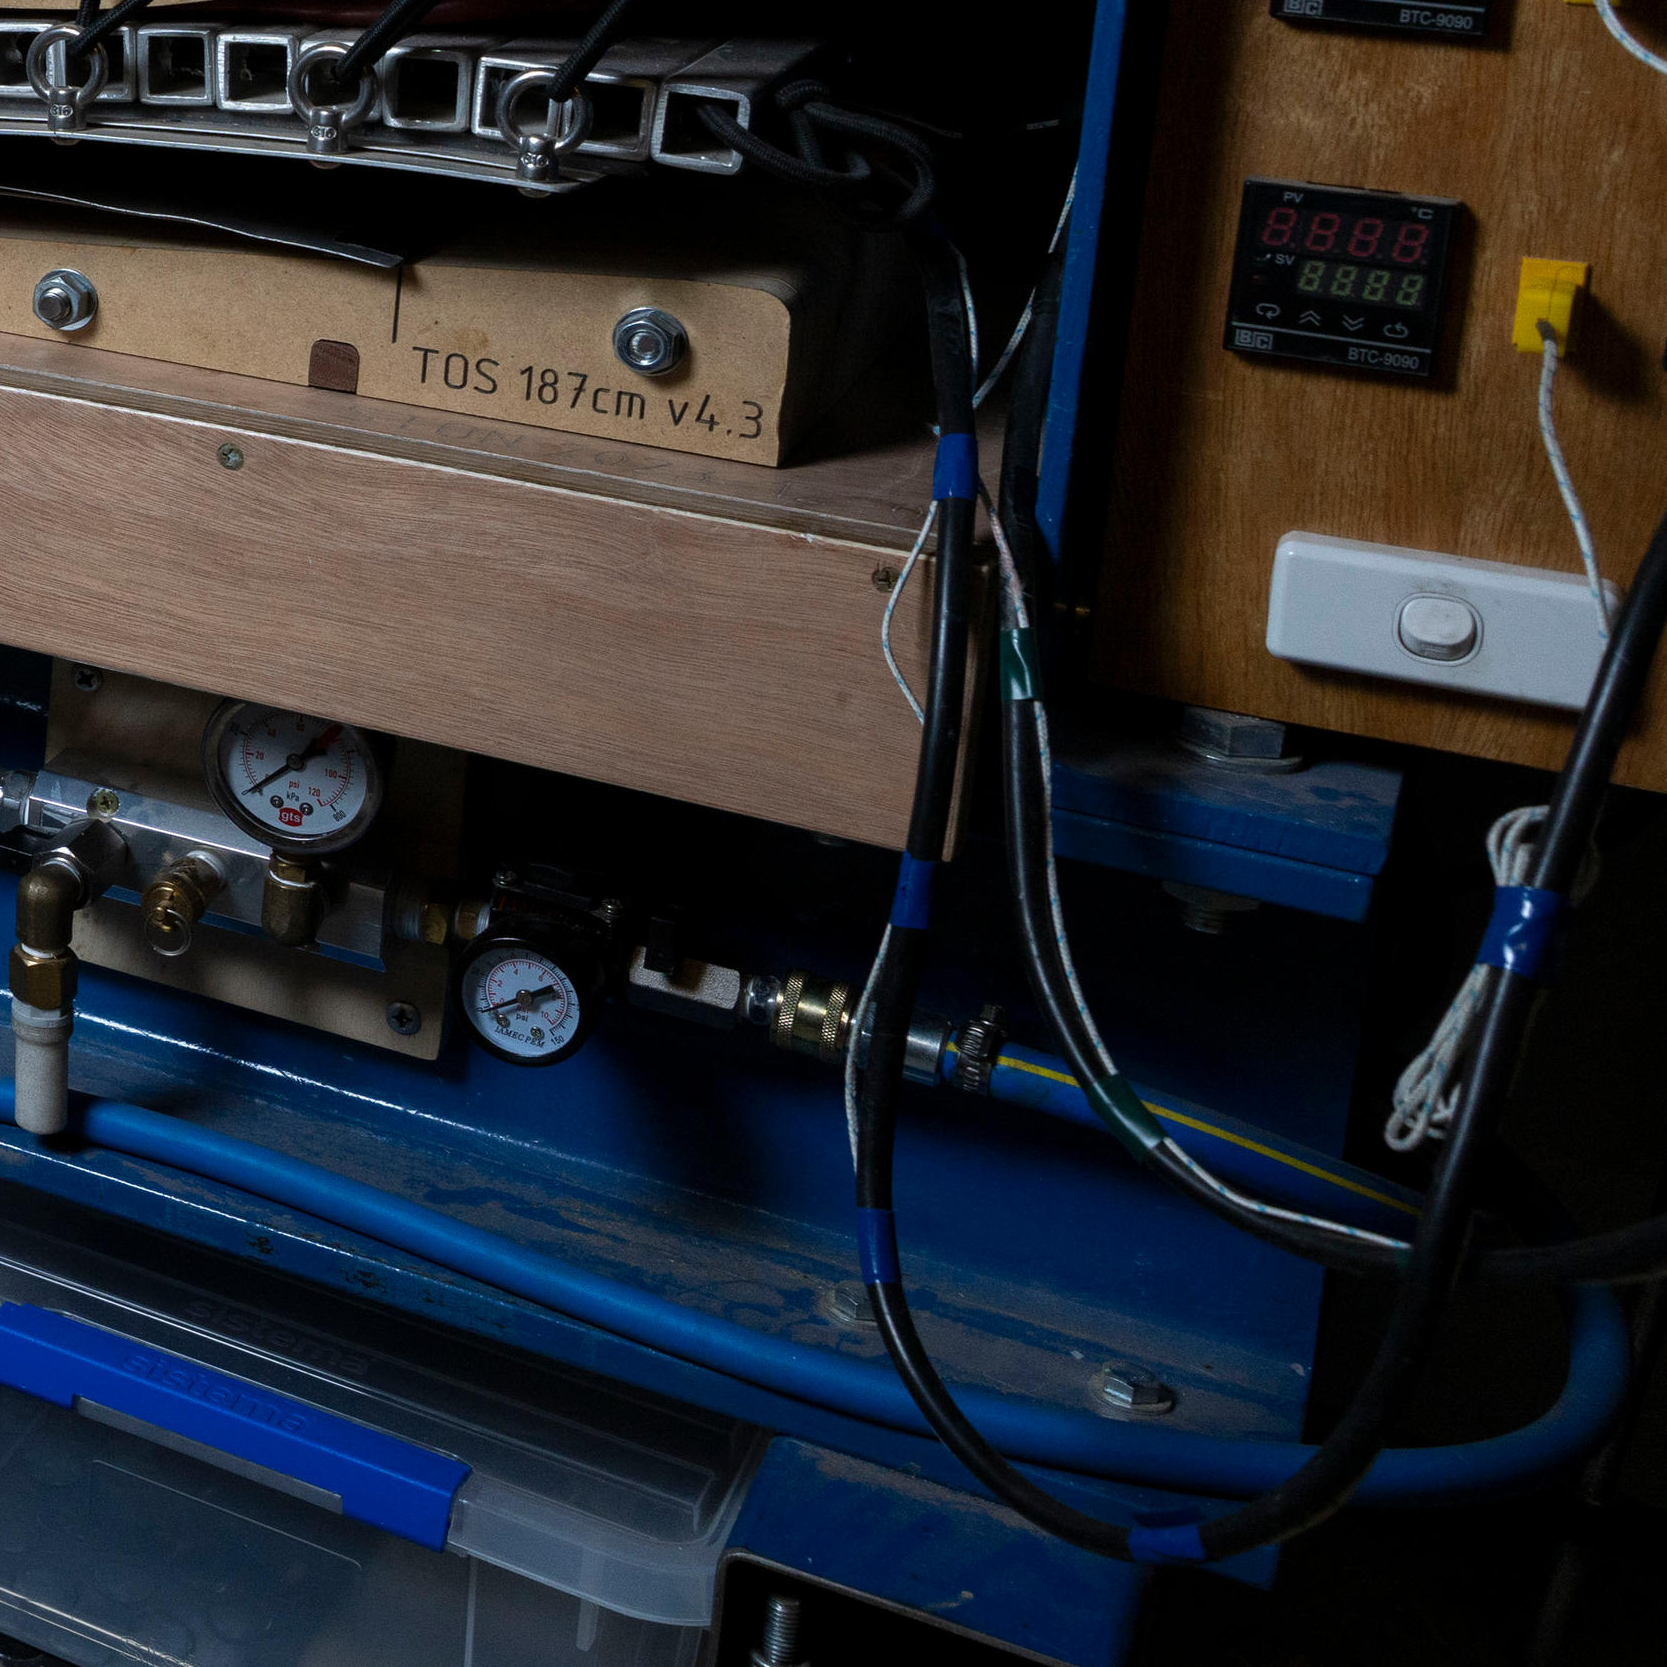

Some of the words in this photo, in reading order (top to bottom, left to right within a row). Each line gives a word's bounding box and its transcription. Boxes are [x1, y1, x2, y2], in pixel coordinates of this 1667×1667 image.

[1399, 8, 1474, 30] BTC-9090
[1283, 191, 1305, 204] PV
[1274, 253, 1296, 266] SV
[1347, 347, 1420, 369] BTC-9090
[412, 345, 500, 395] TOS
[520, 365, 645, 420] 187cm
[668, 394, 764, 440] v4.3
[255, 748, 265, 761] 20
[325, 768, 338, 779] 100
[288, 780, 300, 790] psi
[286, 791, 300, 802] kPa
[308, 787, 321, 798] 120
[281, 810, 301, 823] gts
[516, 1013, 528, 1022] psi
[541, 1011, 549, 1020] 10
[494, 1026, 525, 1041] JAMEC
[550, 1034, 565, 1046] 150
[123, 1353, 310, 1435] sistema
